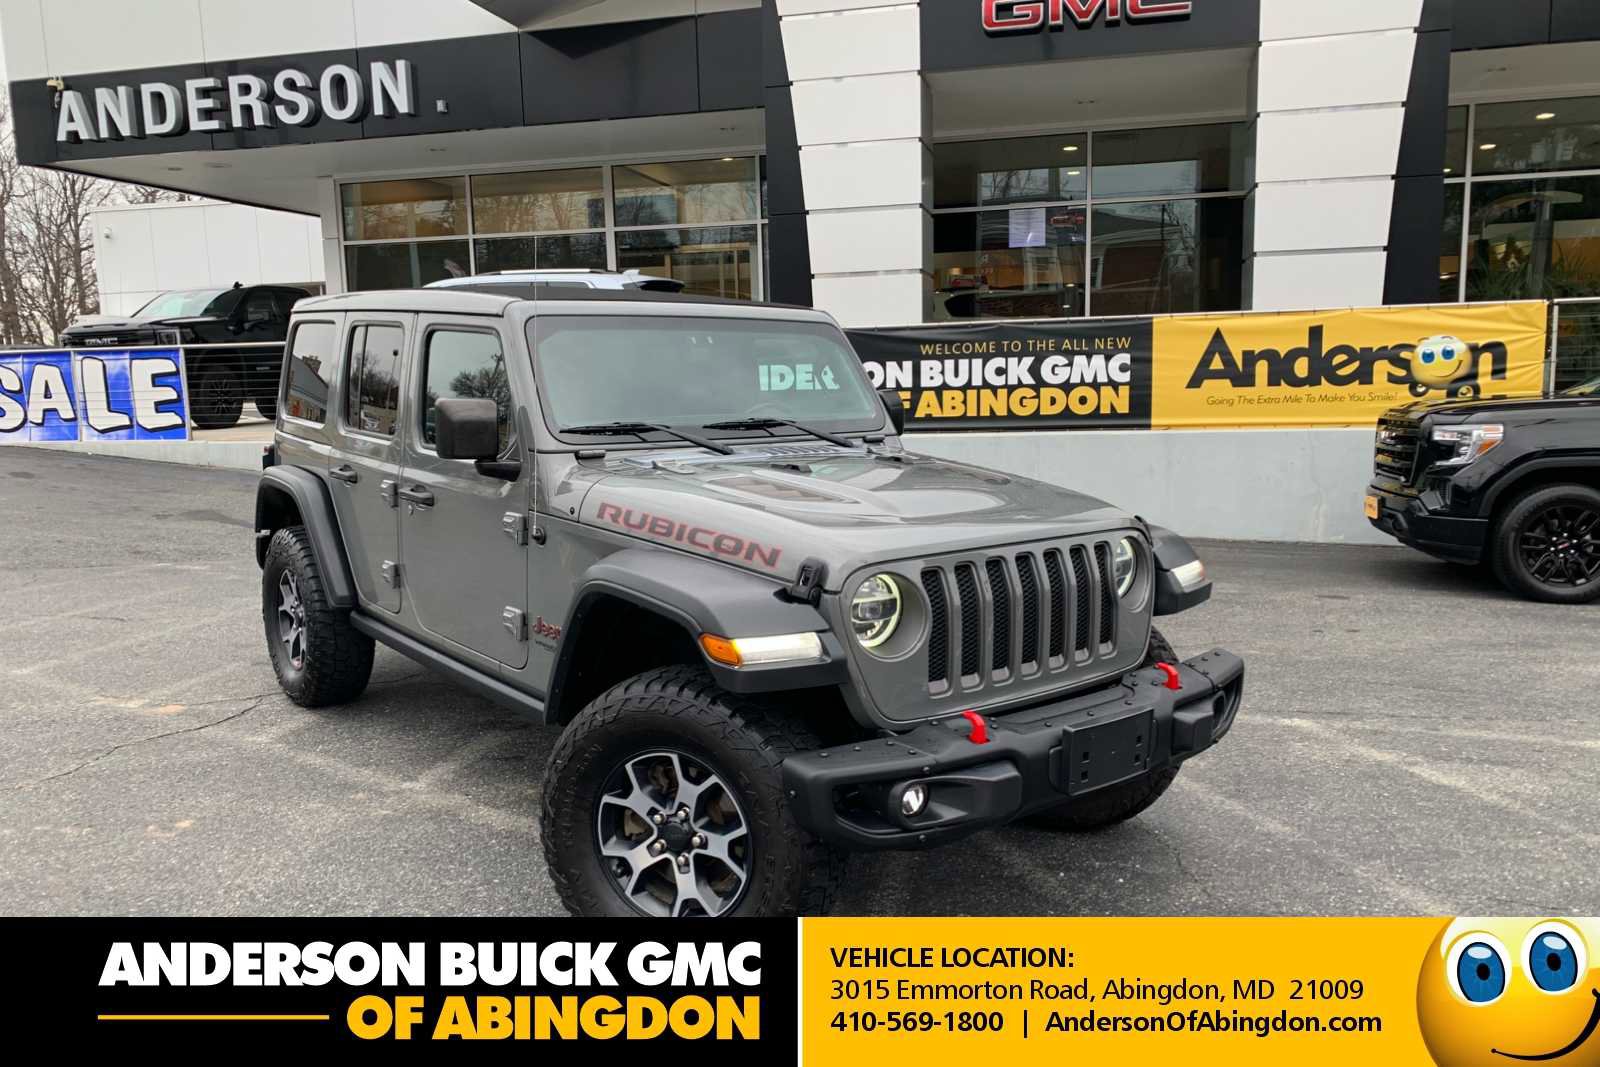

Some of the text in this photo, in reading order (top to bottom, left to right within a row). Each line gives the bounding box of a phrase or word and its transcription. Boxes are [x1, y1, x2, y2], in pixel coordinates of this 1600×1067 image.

[56, 59, 415, 142] ANDERSON
[920, 336, 1131, 355] WELCOME TO THE ALL NEW
[920, 356, 1037, 388] BUICK
[1040, 352, 1131, 384] GMC
[1186, 324, 1507, 390] Andersn
[0, 356, 186, 434] SALE
[914, 385, 1130, 417] ABINGDON
[1206, 395, 1234, 407] Going
[1237, 395, 1255, 405] The
[1256, 394, 1281, 404] Extra
[1305, 393, 1316, 403] To
[1318, 393, 1346, 402] Make
[1348, 392, 1366, 402] You
[1367, 391, 1398, 402] Smile!
[597, 501, 783, 569] RUBICON
